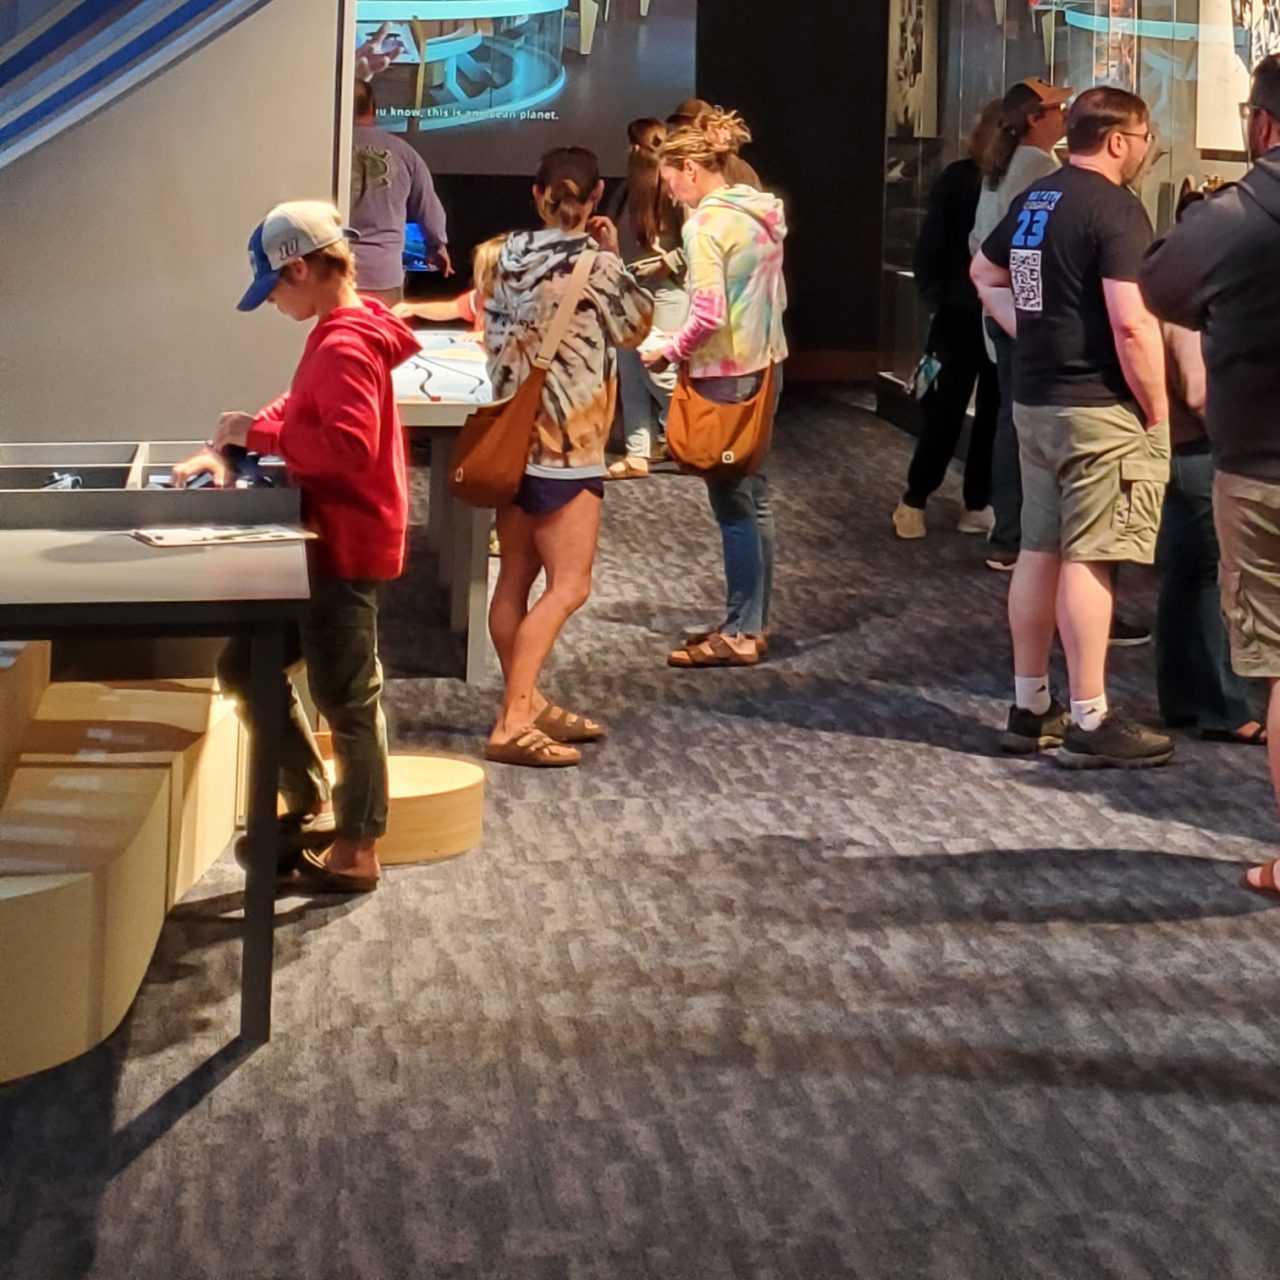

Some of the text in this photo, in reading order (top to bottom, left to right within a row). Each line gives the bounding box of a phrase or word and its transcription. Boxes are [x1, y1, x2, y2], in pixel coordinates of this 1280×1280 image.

[390, 107, 423, 118] know,
[427, 107, 448, 118] this
[452, 108, 461, 118] is
[520, 110, 559, 121] planet.
[1012, 209, 1049, 247] 23
